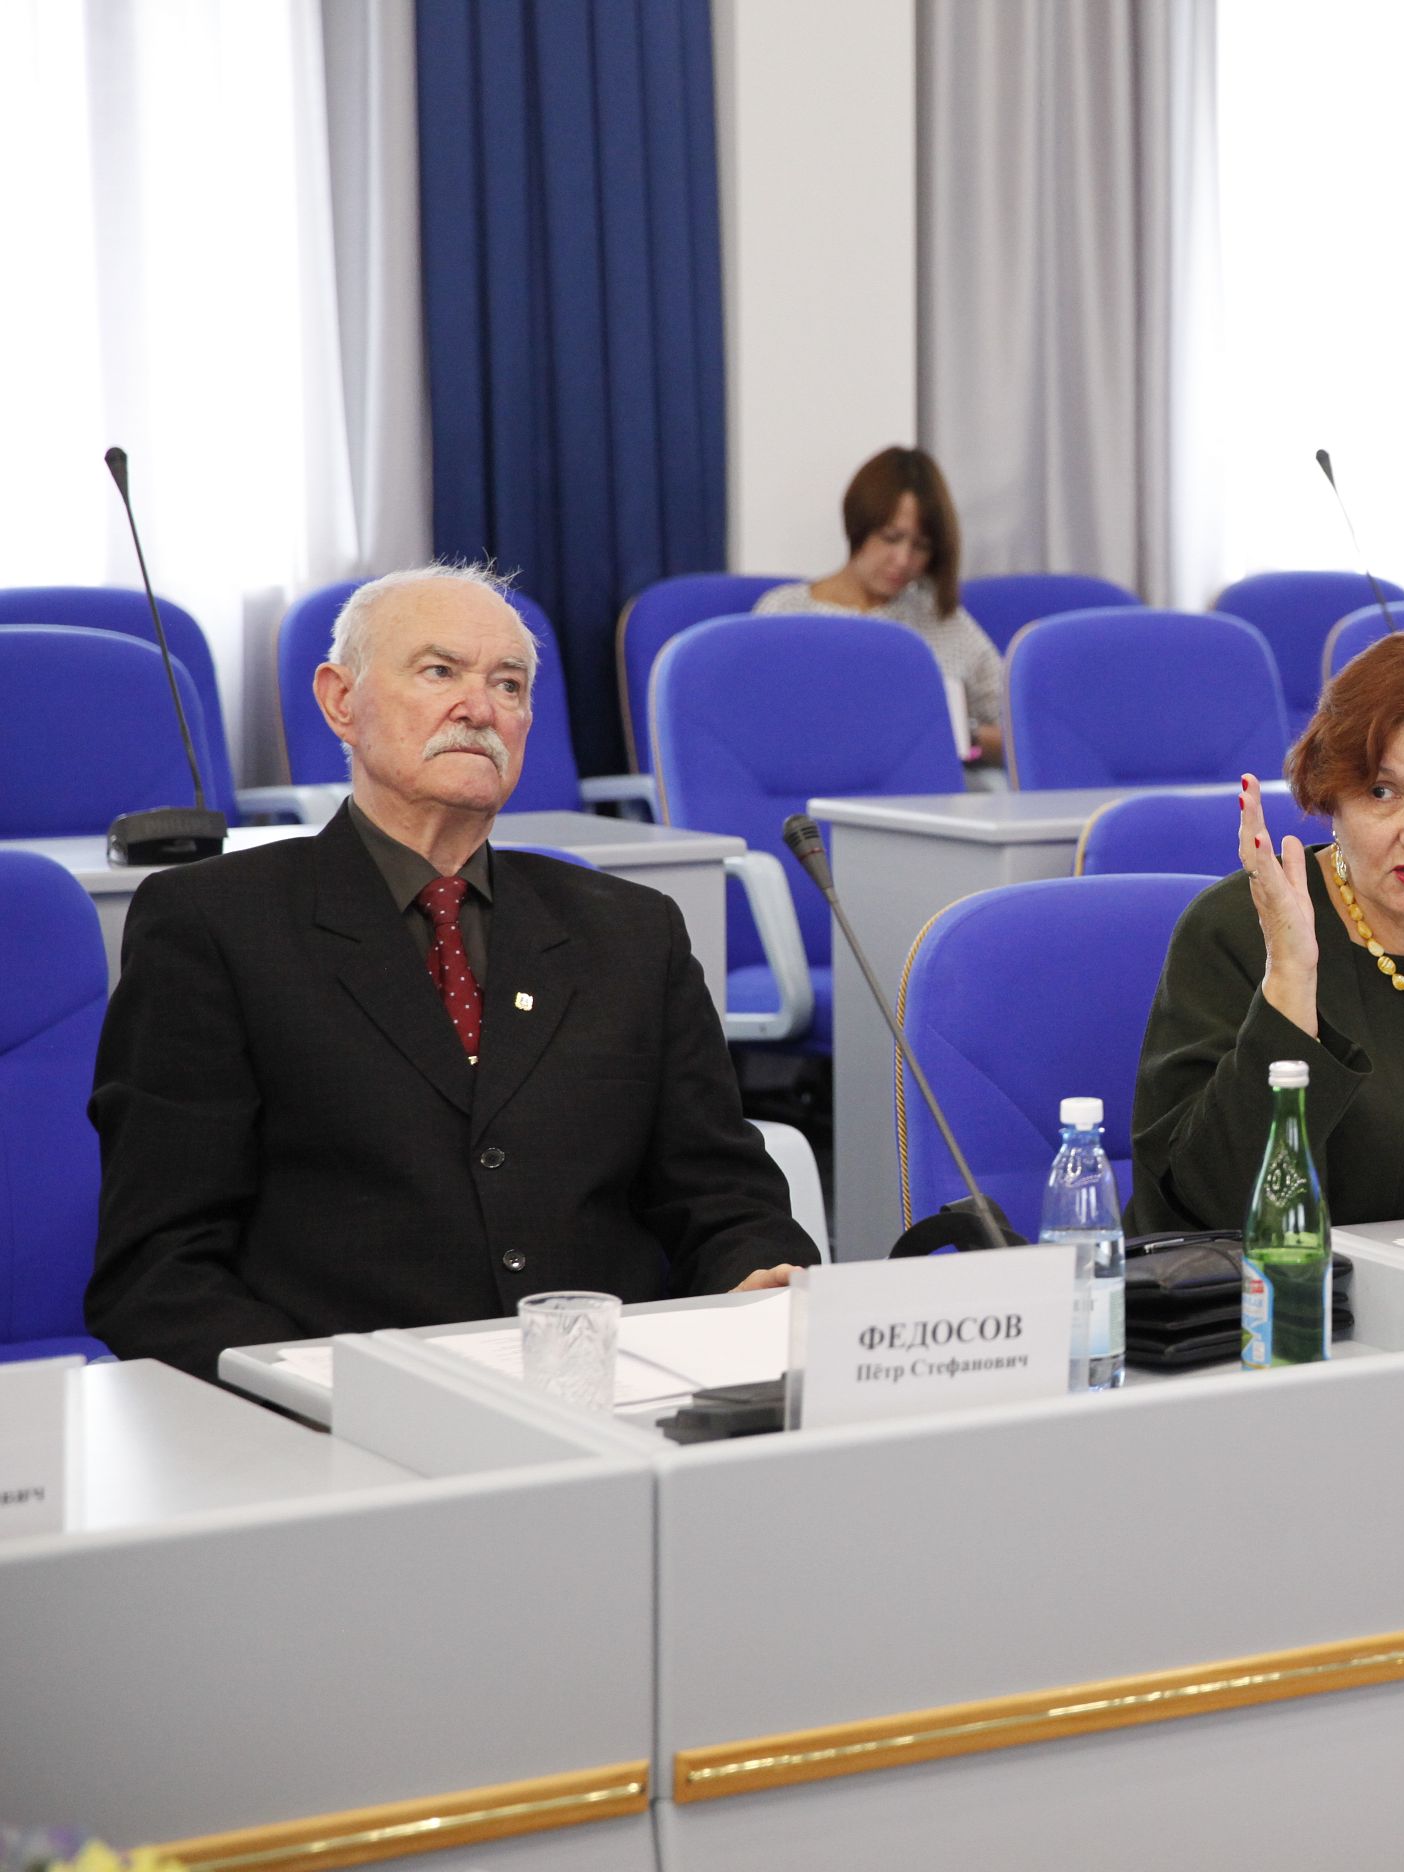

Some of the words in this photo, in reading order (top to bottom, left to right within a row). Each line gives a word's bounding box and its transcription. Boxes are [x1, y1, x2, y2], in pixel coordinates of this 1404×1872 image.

[858, 1313, 1023, 1352] ФЕДОСОВ
[856, 1361, 905, 1383] Пётр
[910, 1354, 1029, 1379] Стефанович
